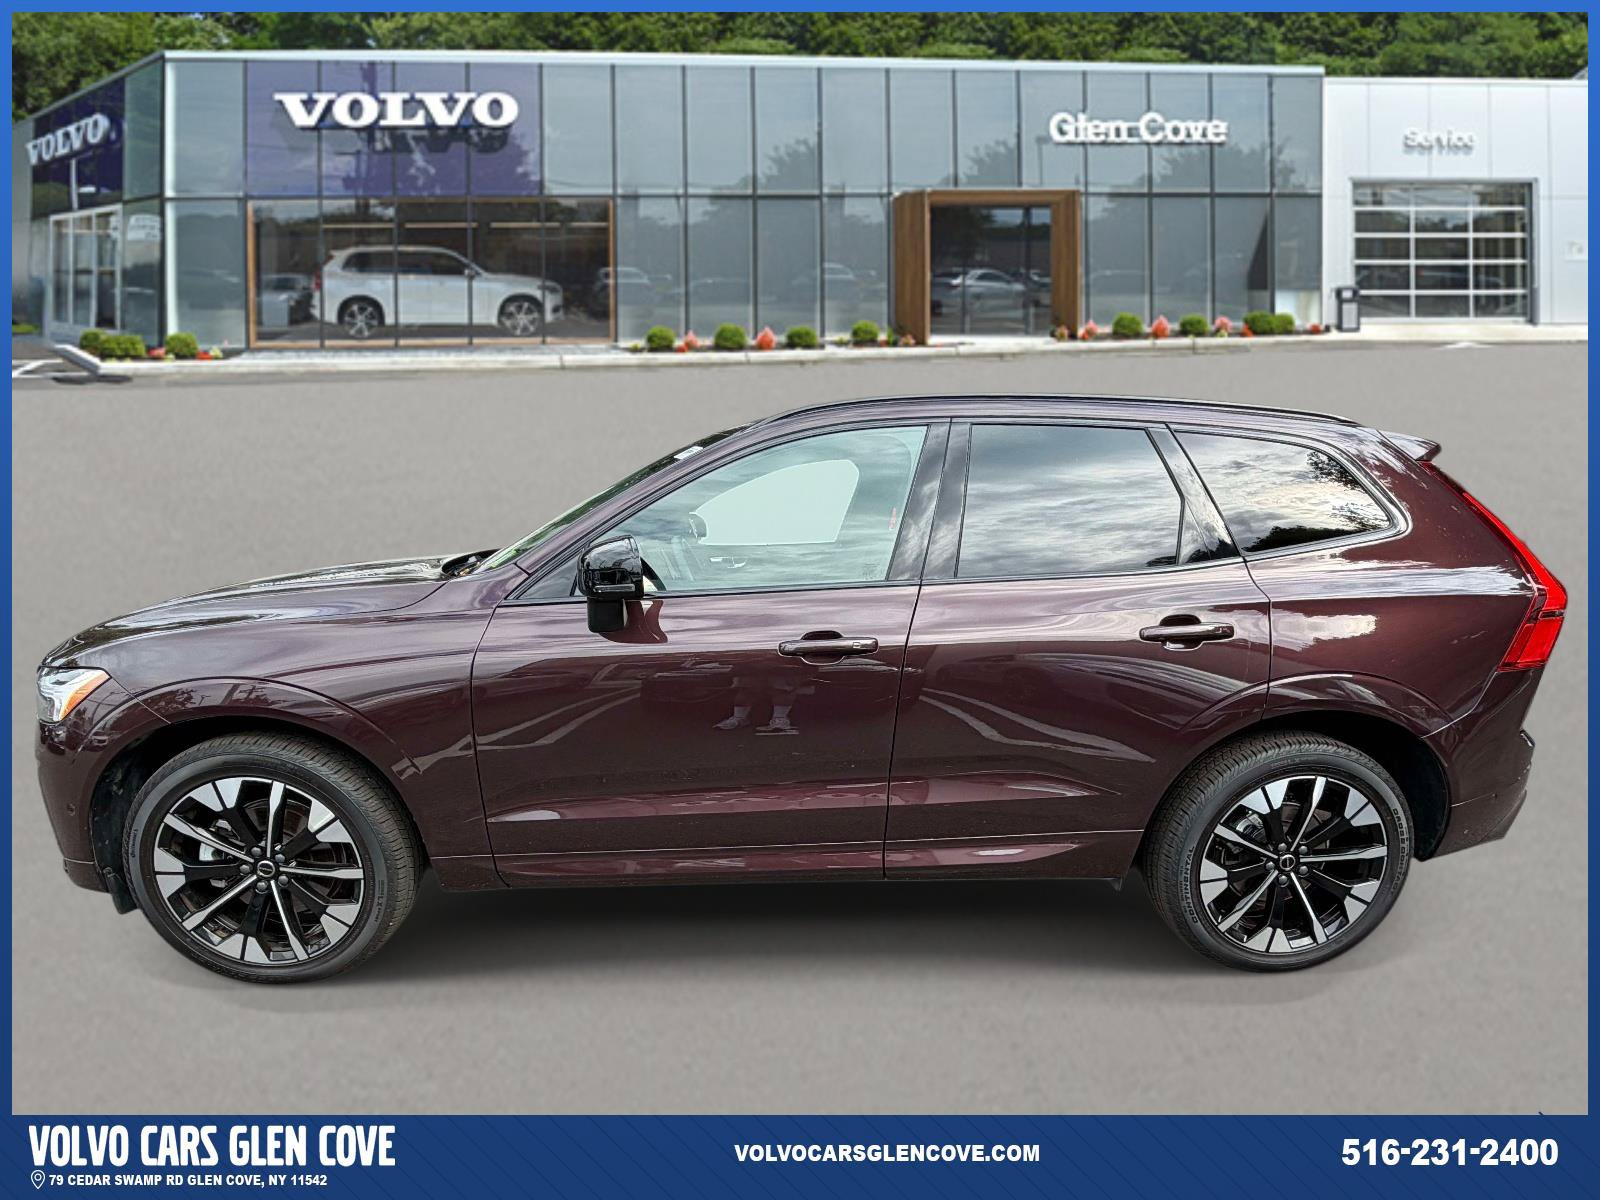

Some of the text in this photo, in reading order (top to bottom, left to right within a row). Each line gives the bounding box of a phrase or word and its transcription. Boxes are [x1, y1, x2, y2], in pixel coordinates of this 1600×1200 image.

[274, 91, 519, 128] VOLVO
[25, 113, 110, 166] VOLVO
[1049, 111, 1229, 144] Glen Cove
[1402, 127, 1476, 154] Service
